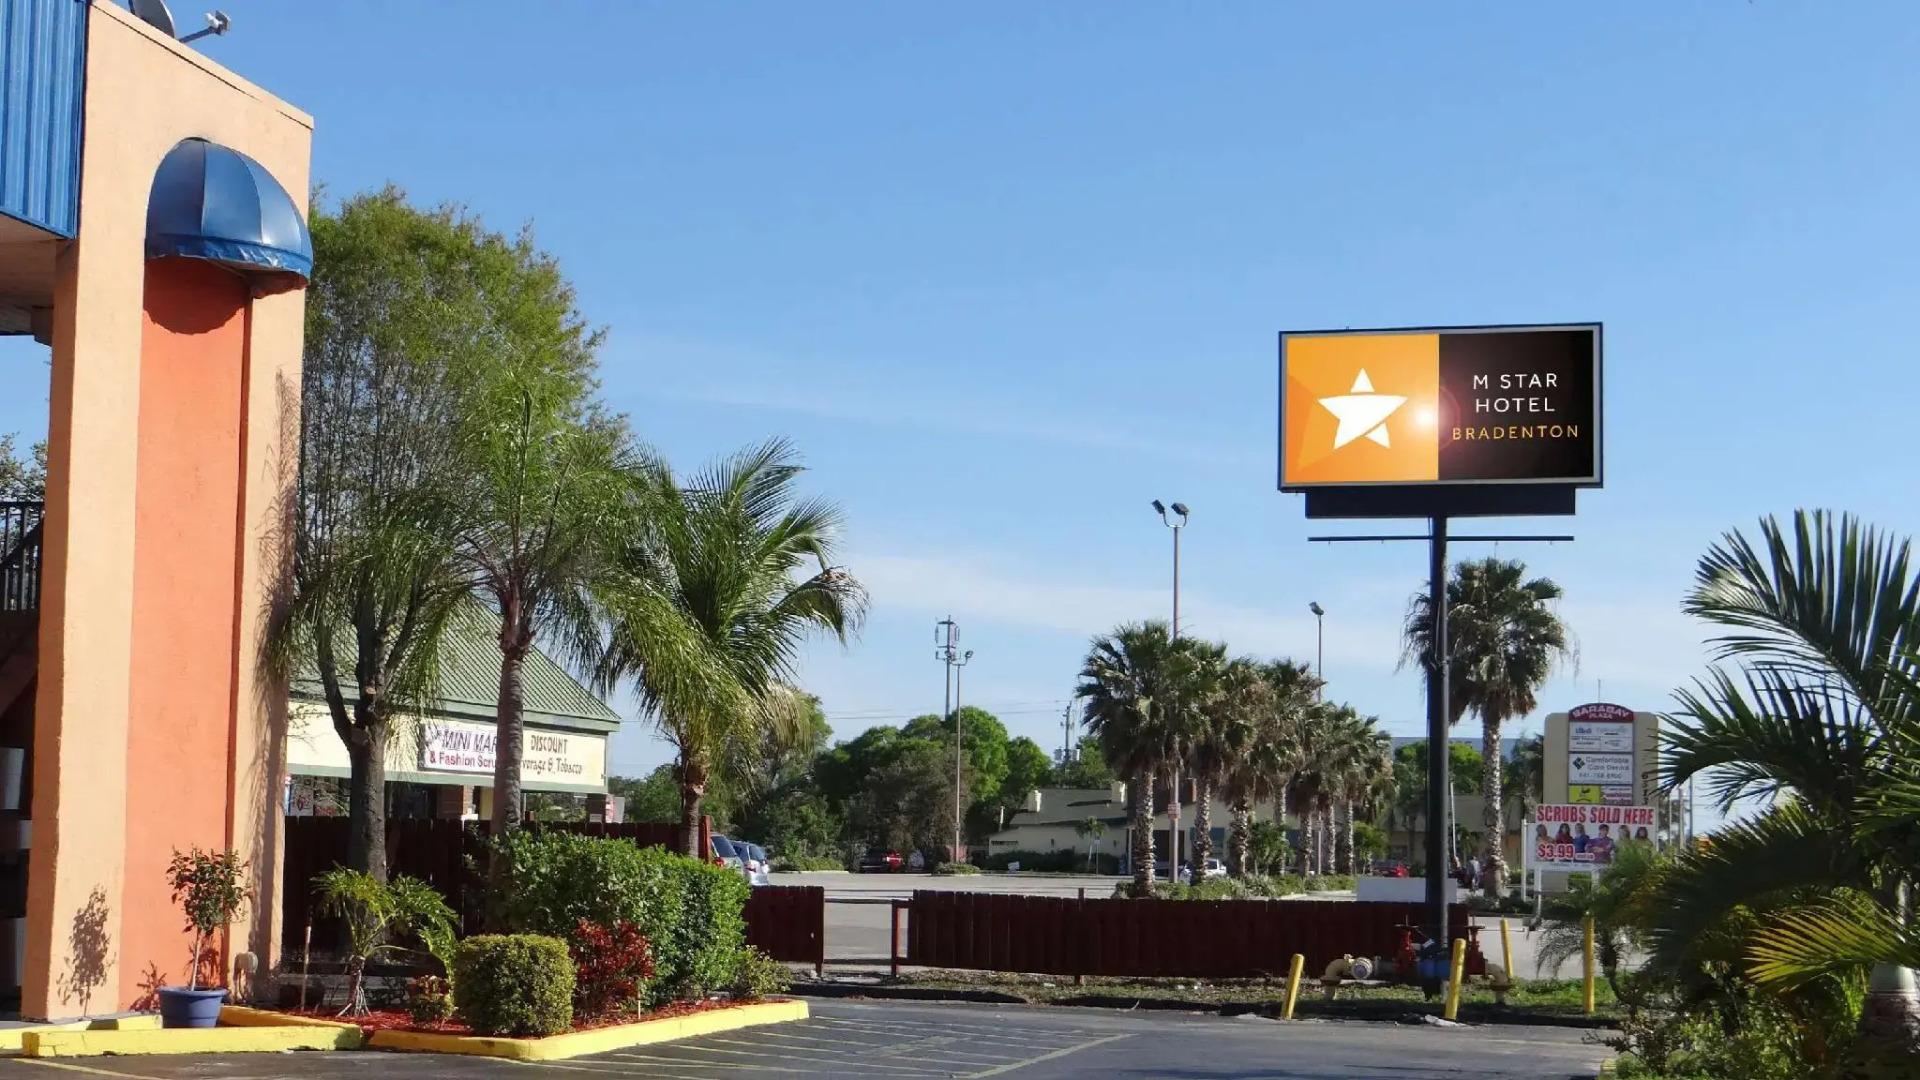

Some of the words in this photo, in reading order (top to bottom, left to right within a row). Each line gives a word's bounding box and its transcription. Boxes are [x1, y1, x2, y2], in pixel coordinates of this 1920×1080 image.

[1473, 374, 1489, 390] M
[1500, 373, 1557, 389] STAR
[1475, 397, 1555, 413] HOTEL
[1452, 425, 1578, 440] BRADENTON
[442, 729, 471, 751] MINI
[473, 733, 497, 753] MAR
[530, 734, 568, 754] DISCOUNT
[430, 750, 437, 764] &
[439, 752, 475, 767] Fashion
[477, 755, 496, 768] Scru
[522, 759, 546, 775] verage
[556, 757, 582, 775] Tobacco
[1537, 805, 1587, 824] SCRUBS
[1590, 806, 1621, 824] SOLD
[1623, 808, 1655, 825] HERE
[1537, 843, 1574, 859] $3.99
